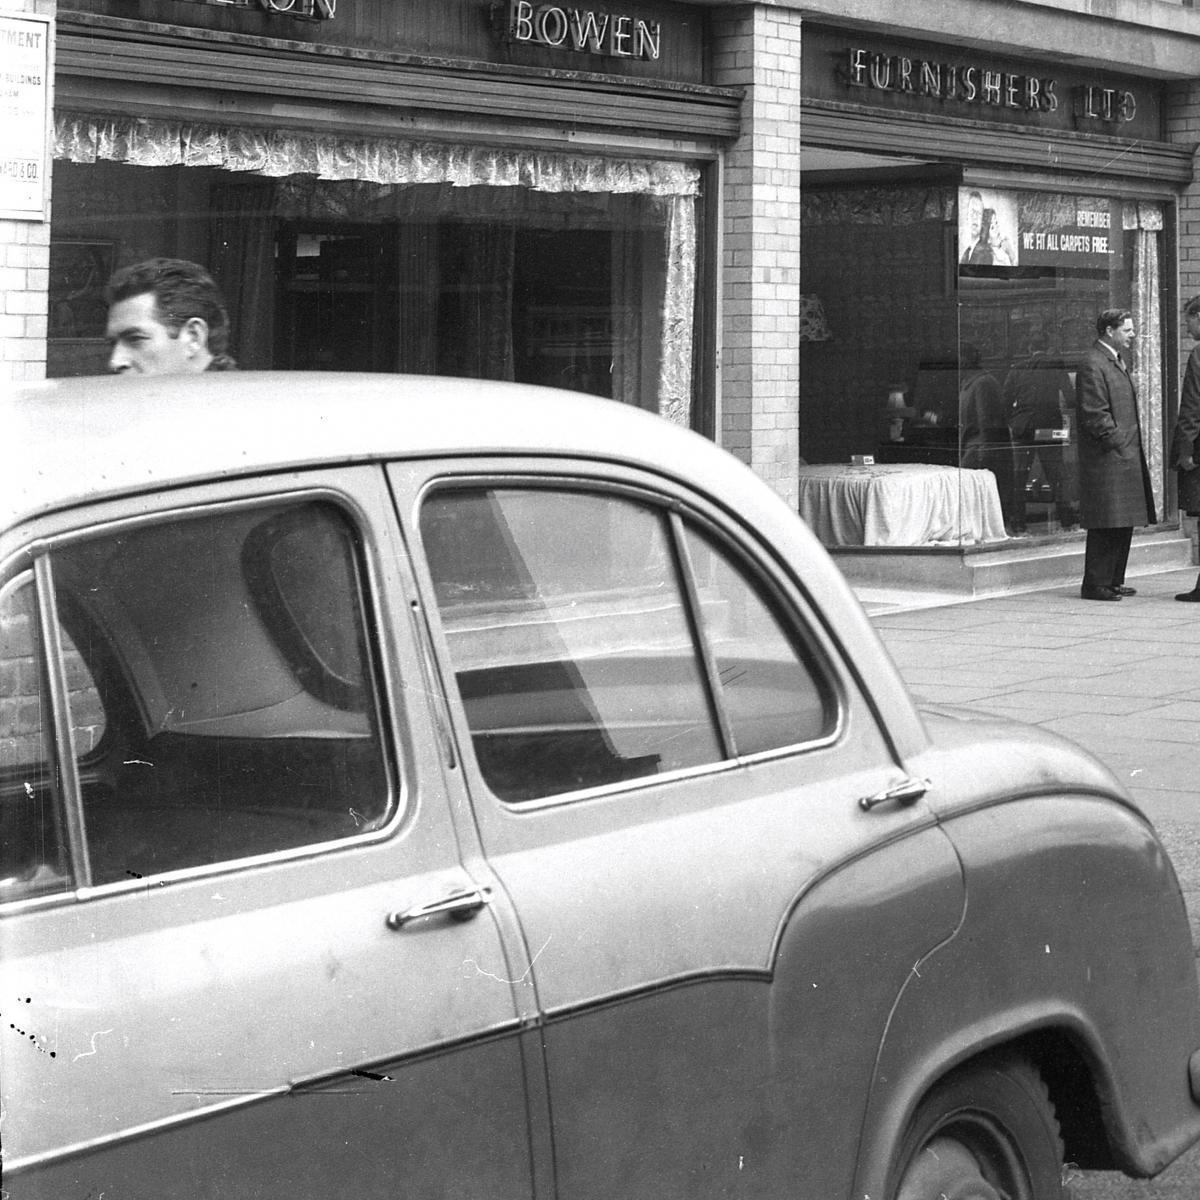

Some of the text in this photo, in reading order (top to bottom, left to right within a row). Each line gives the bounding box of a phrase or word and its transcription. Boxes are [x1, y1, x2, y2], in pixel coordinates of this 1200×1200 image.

[510, 0, 660, 60] BOWEN
[850, 49, 1136, 121] FURNISHERS LTD
[0, 161, 18, 177] ARD
[1077, 210, 1111, 229] REMEMBER
[1023, 232, 1034, 250] WE
[1036, 232, 1046, 250] FIT
[1047, 233, 1059, 251] ALL
[1061, 234, 1090, 253] CARPETS
